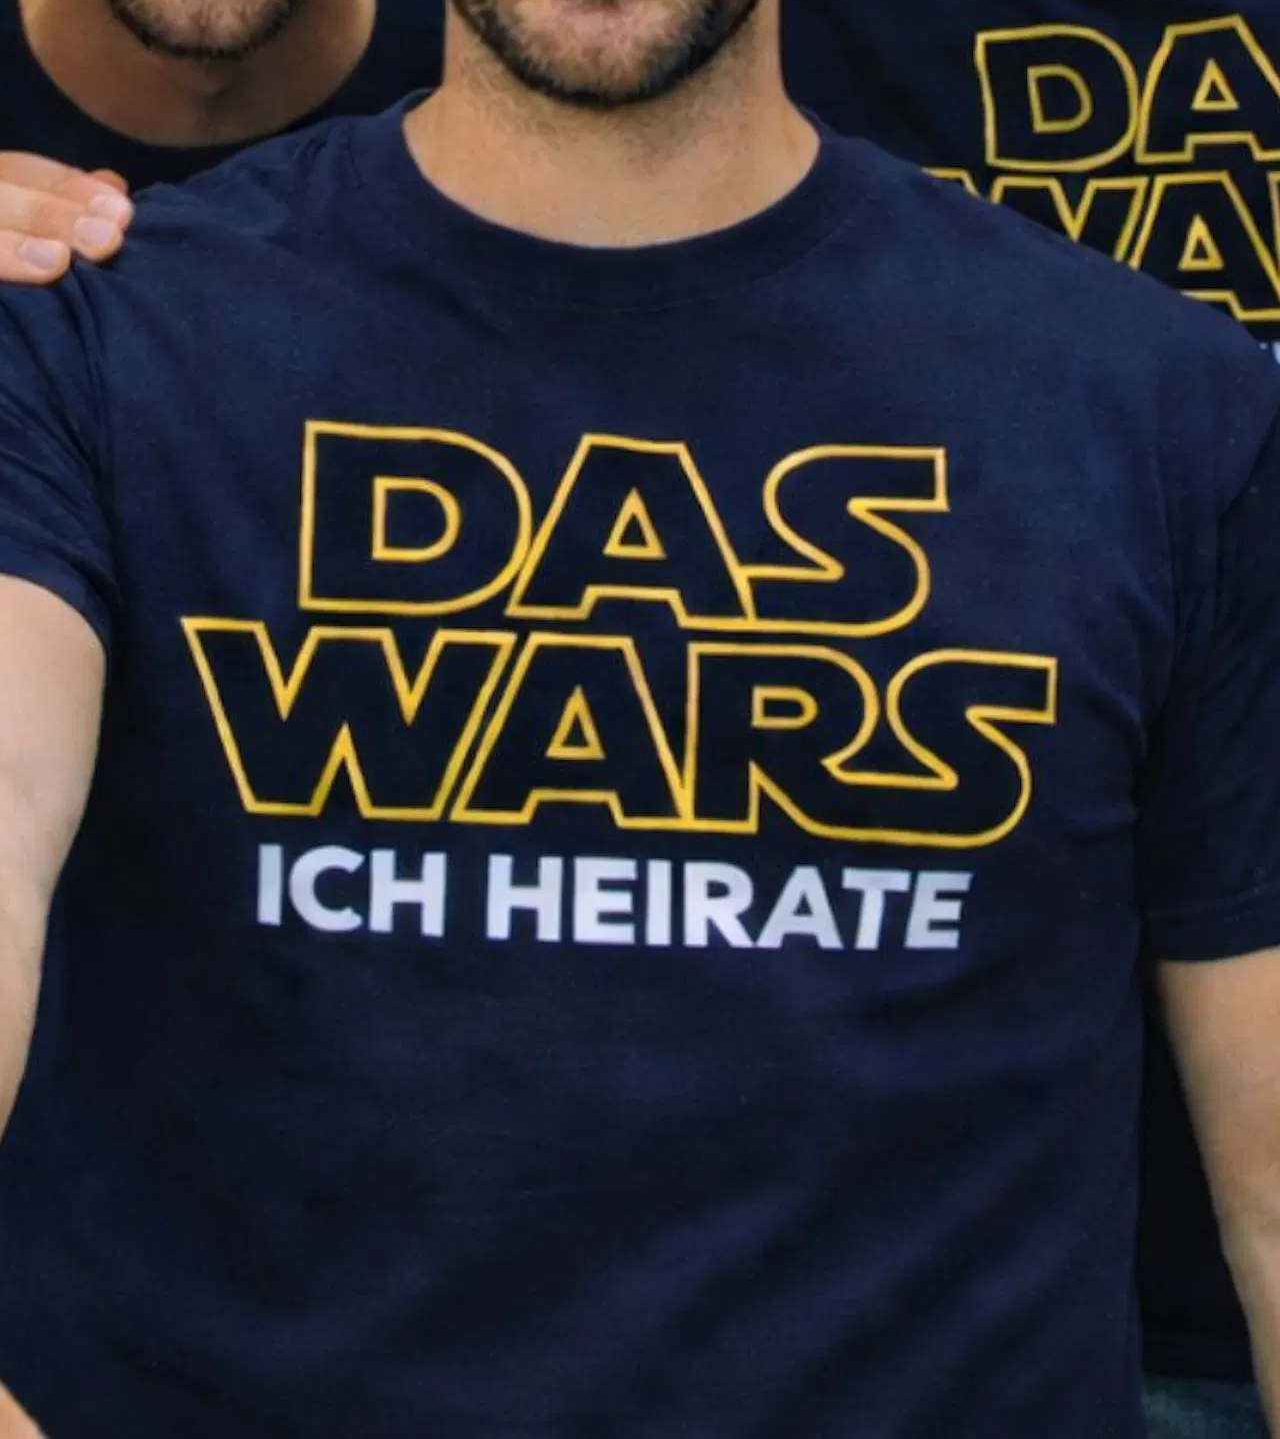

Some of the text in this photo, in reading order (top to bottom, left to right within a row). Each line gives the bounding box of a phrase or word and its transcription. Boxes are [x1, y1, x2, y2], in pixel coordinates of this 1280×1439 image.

[298, 420, 950, 638] DAS
[180, 616, 1059, 848] WARS
[257, 844, 972, 951] ICH HEIRATE
